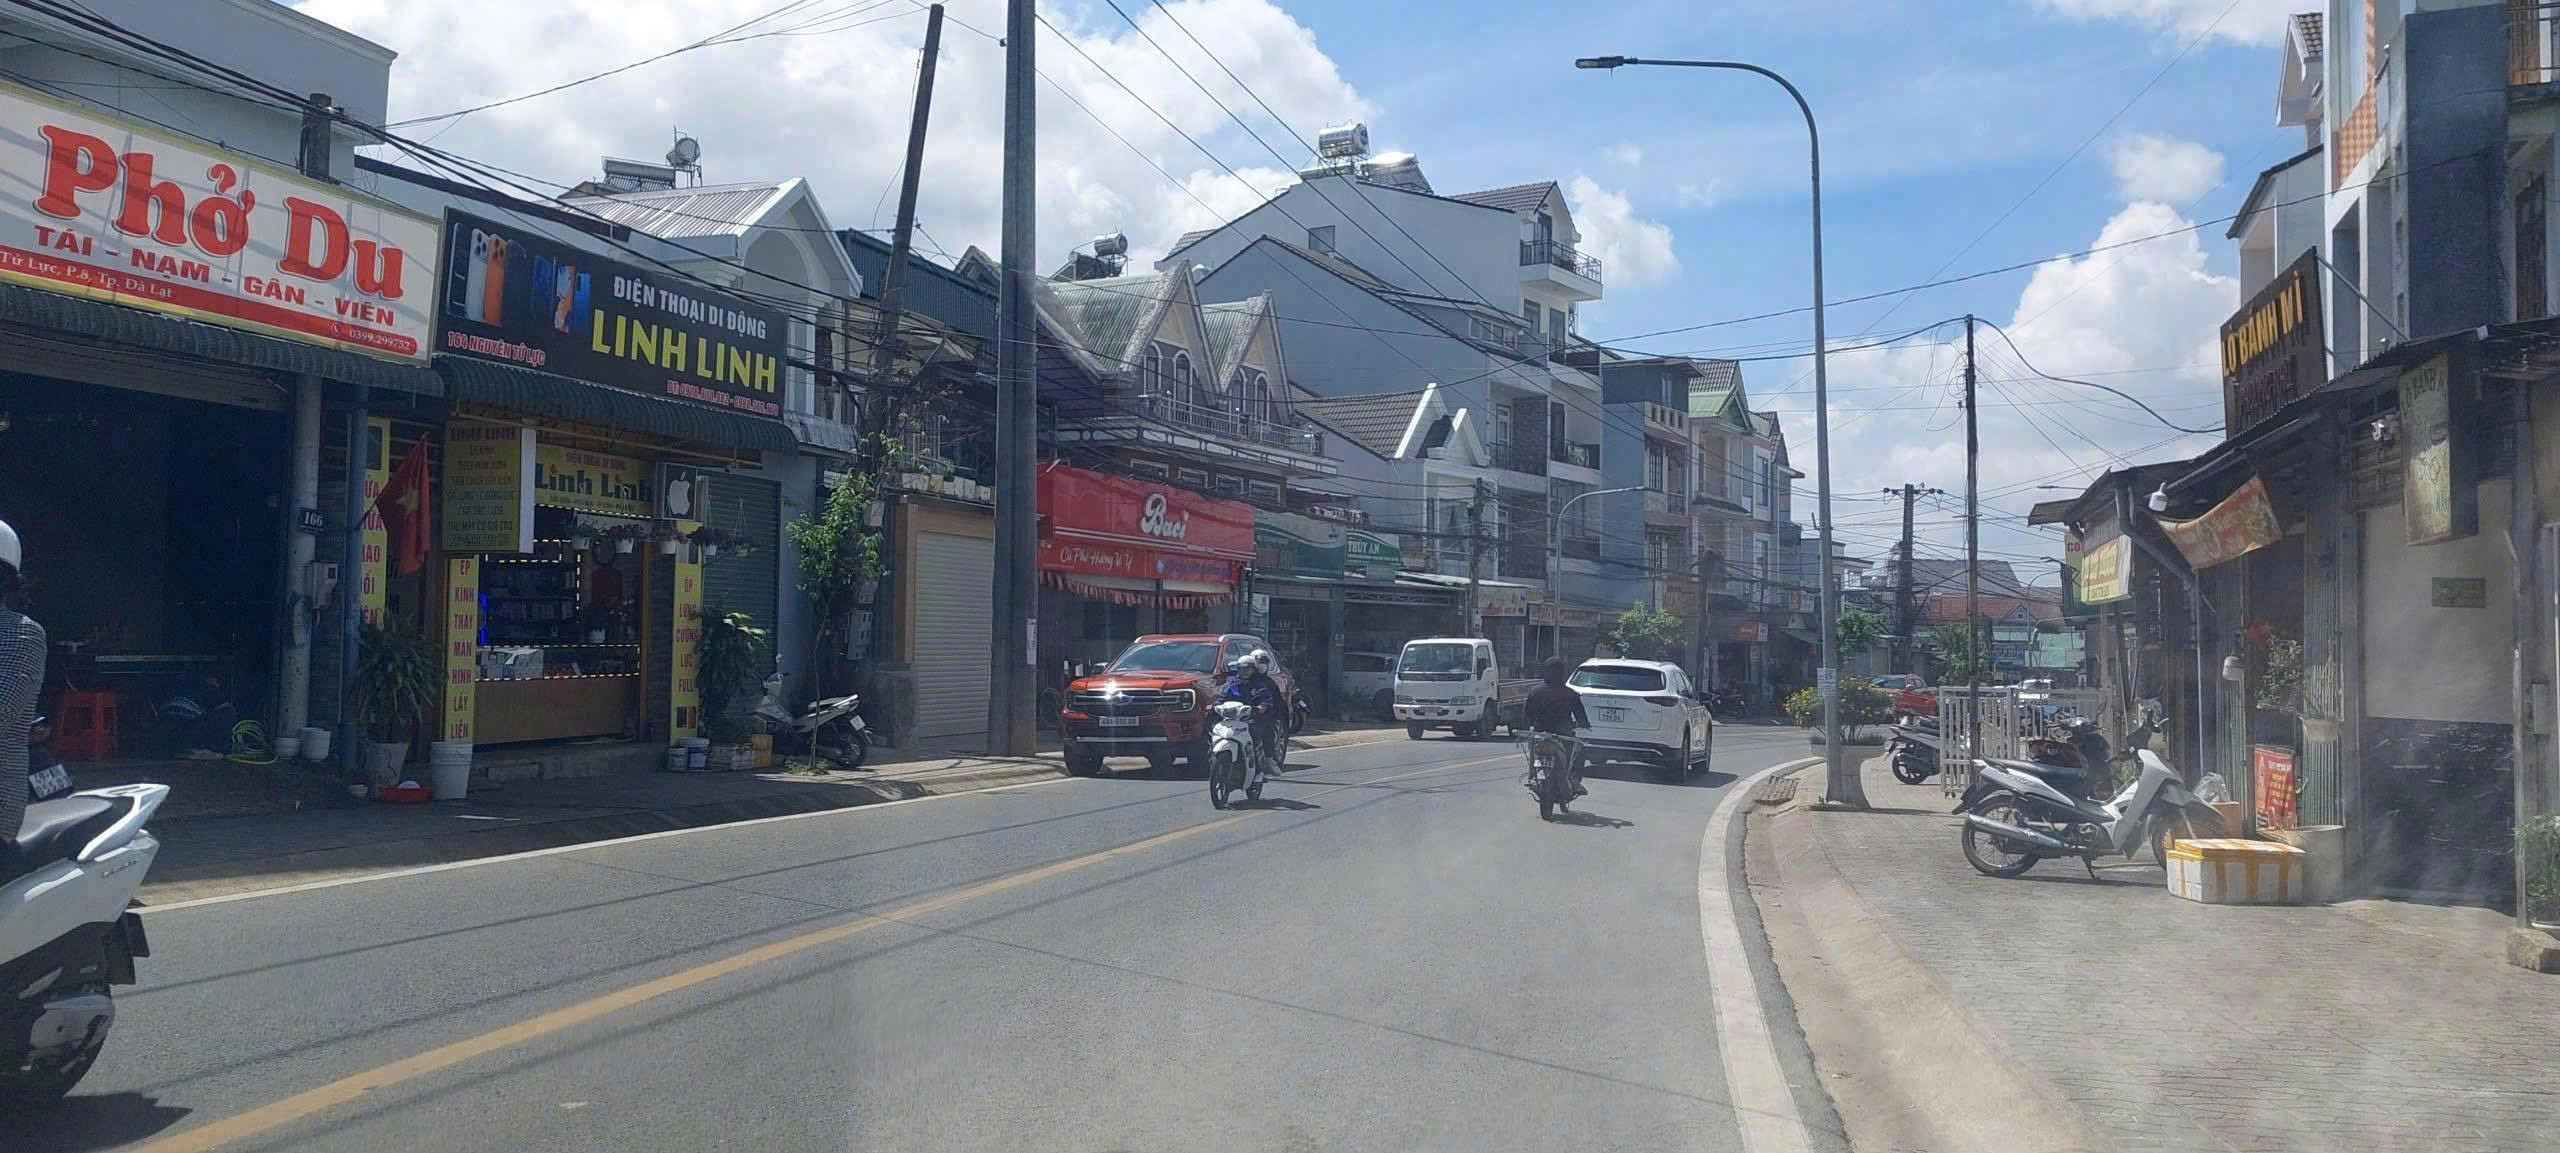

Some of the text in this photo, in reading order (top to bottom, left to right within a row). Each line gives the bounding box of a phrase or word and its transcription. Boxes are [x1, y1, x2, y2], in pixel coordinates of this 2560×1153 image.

[32, 124, 405, 300] Phở Du
[34, 224, 93, 257] TÁI
[131, 248, 210, 284] NẠM
[335, 296, 396, 328] VIÊN
[613, 275, 768, 340] ĐIỆN THOẠI DI ĐỘNG
[447, 330, 468, 350] 164
[2239, 300, 2279, 366] BÁNH
[591, 308, 777, 394] LINH LINH
[304, 511, 324, 527] 166
[1141, 493, 1190, 539] Baci
[455, 584, 474, 603] KÍNH
[454, 614, 473, 631] THAY
[453, 637, 472, 657] MÀN
[679, 678, 696, 693] FULL
